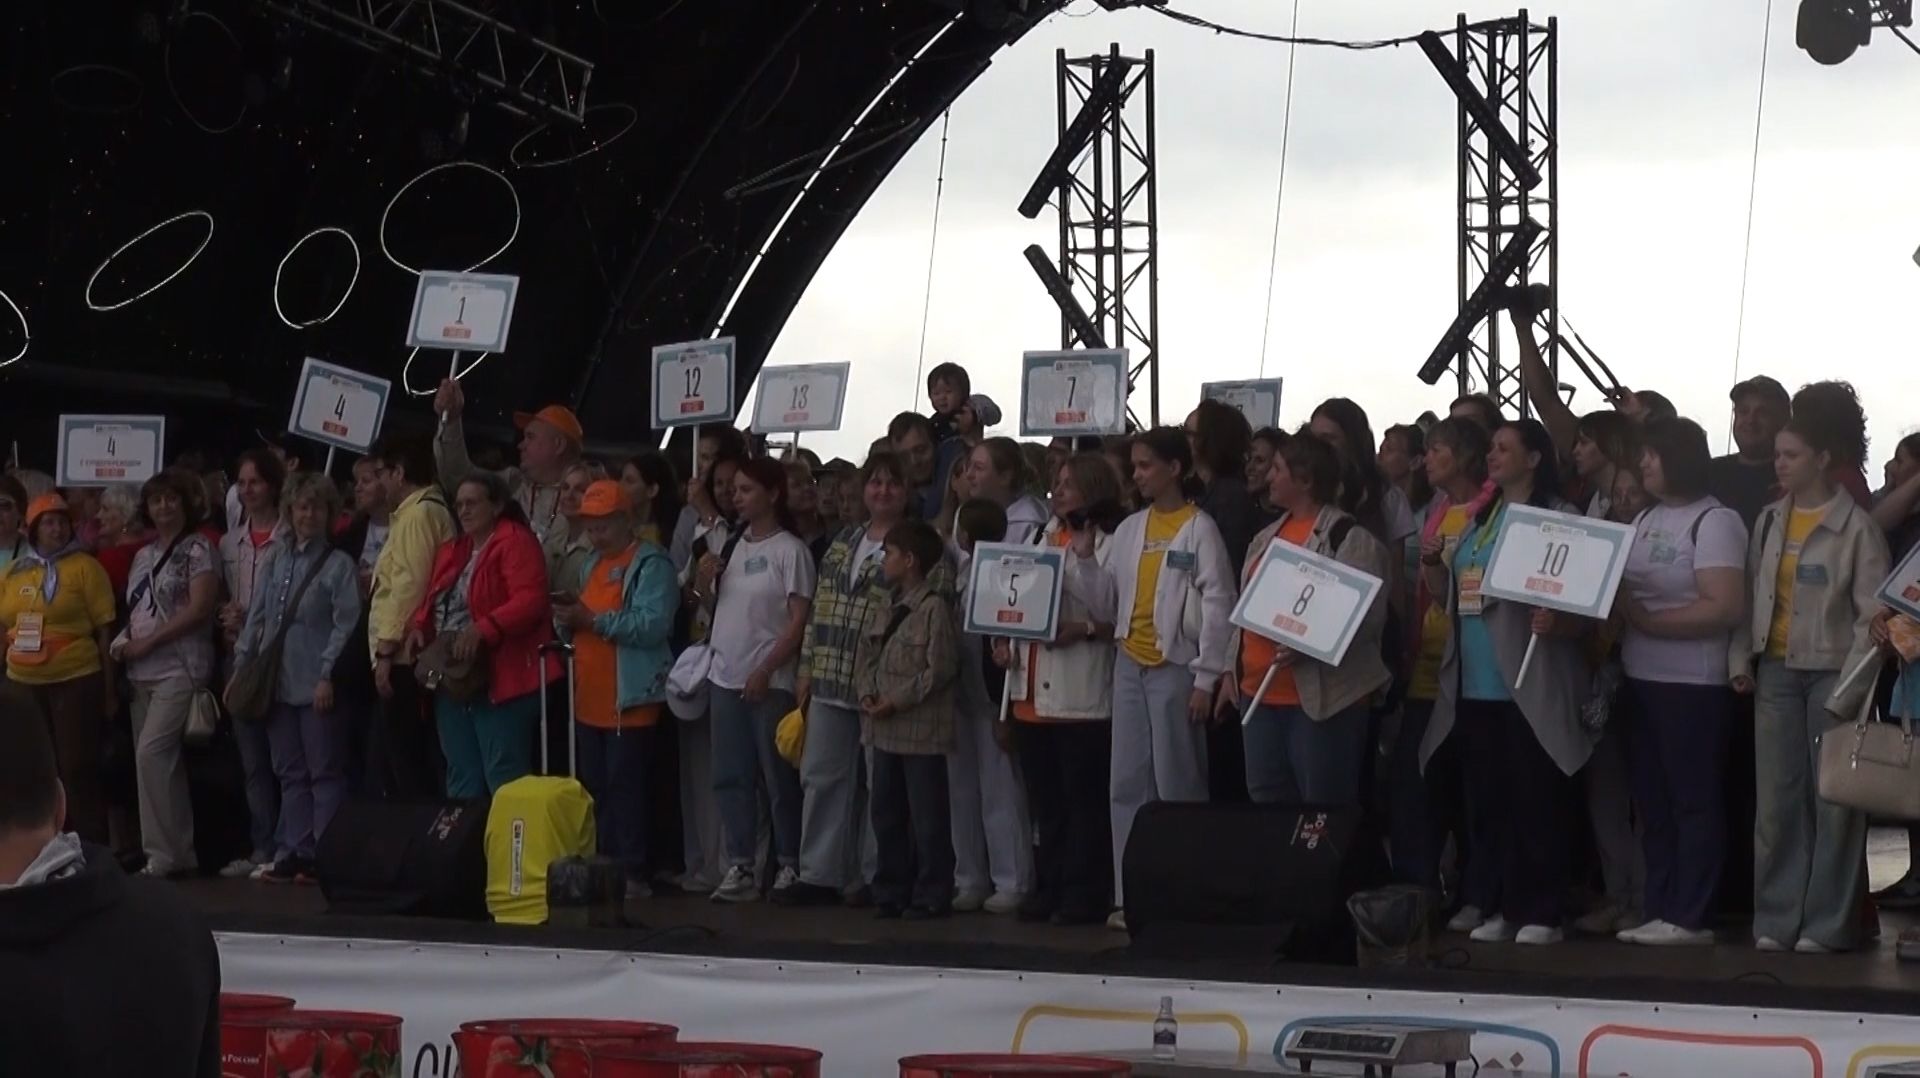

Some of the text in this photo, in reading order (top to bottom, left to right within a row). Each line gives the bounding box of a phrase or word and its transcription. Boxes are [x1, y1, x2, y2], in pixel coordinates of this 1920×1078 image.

[454, 296, 467, 325] 1
[684, 366, 702, 399] 12
[789, 384, 810, 411] 13
[1067, 376, 1076, 409] 7
[334, 393, 346, 421] 4
[107, 435, 116, 457] 4
[1536, 541, 1570, 578] 10
[1007, 573, 1020, 607] 5
[1292, 583, 1315, 617] 8
